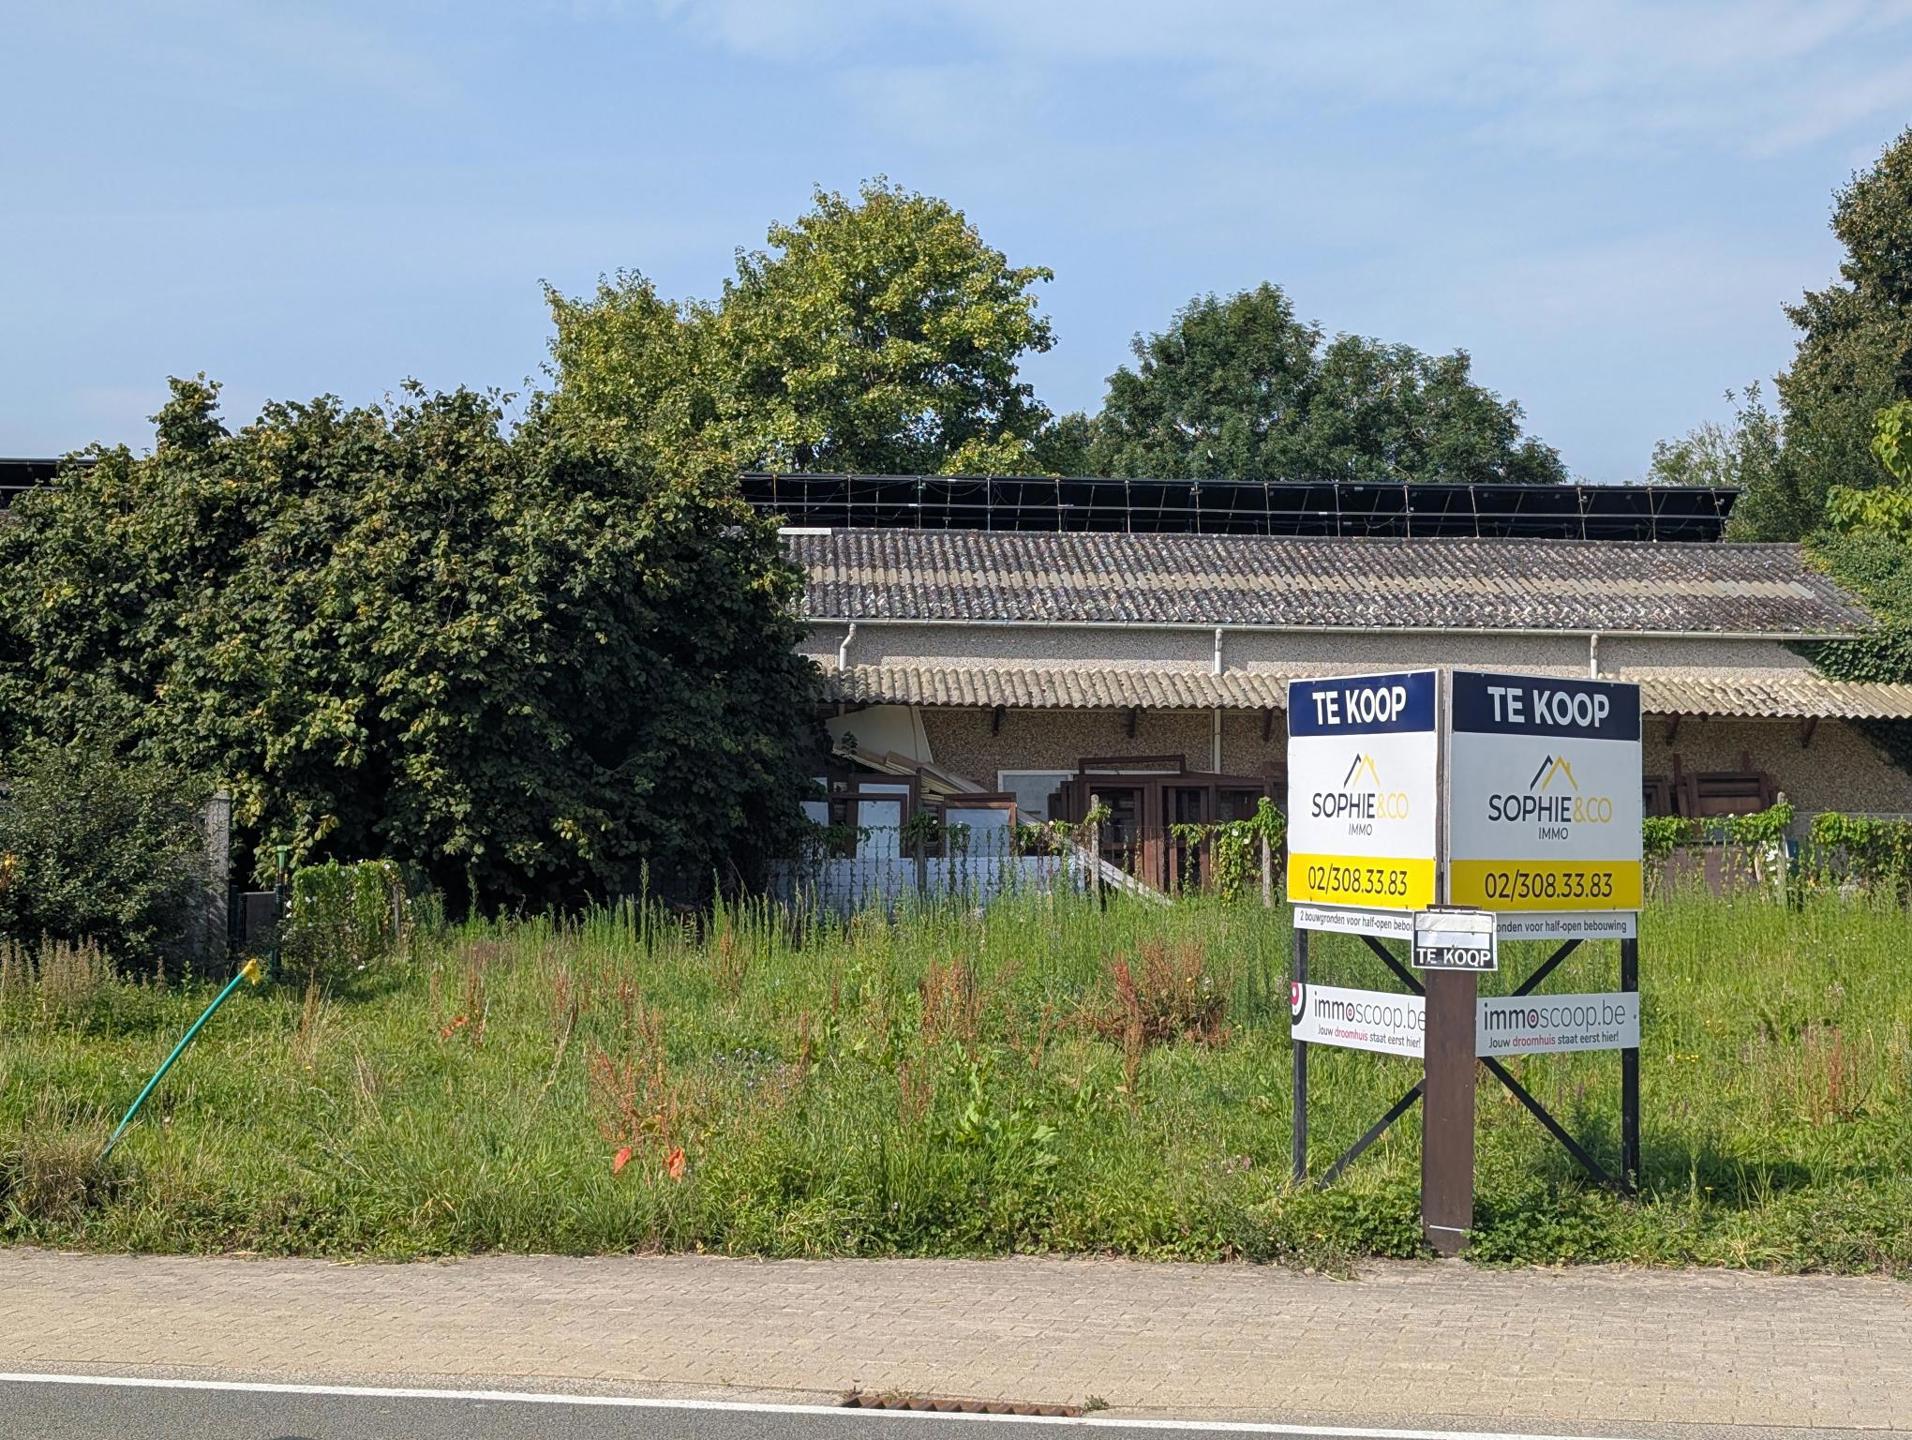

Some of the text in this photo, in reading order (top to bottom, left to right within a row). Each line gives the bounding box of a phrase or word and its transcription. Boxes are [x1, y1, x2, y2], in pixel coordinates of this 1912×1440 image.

[1312, 686, 1406, 725] TE KOOP
[1487, 686, 1610, 728] TE KOOP
[1311, 792, 1409, 819] SOPHIE&CO
[1488, 794, 1613, 823] SOPHIE&CO
[1348, 823, 1373, 836] IMMO
[1538, 827, 1569, 840] IMMO
[1308, 863, 1408, 896] 02/308.33.83
[1485, 869, 1613, 902] 02/308.33.83
[1300, 910, 1307, 921] 2
[1305, 912, 1345, 926] bouwgronden
[1346, 917, 1361, 925] voor
[1362, 916, 1392, 930] half-open
[1524, 922, 1544, 932] voor
[1545, 921, 1582, 934] half-open
[1583, 919, 1627, 932] bebouwing
[1416, 948, 1437, 964] TE
[1314, 991, 1426, 1034] immoscoop.be
[1484, 1000, 1626, 1032] immoscoop.be
[1318, 1024, 1421, 1048] Jouw droomhuis staat eerst hier!
[1489, 1031, 1619, 1048] Jouw droomhuis staat eerst hier!
